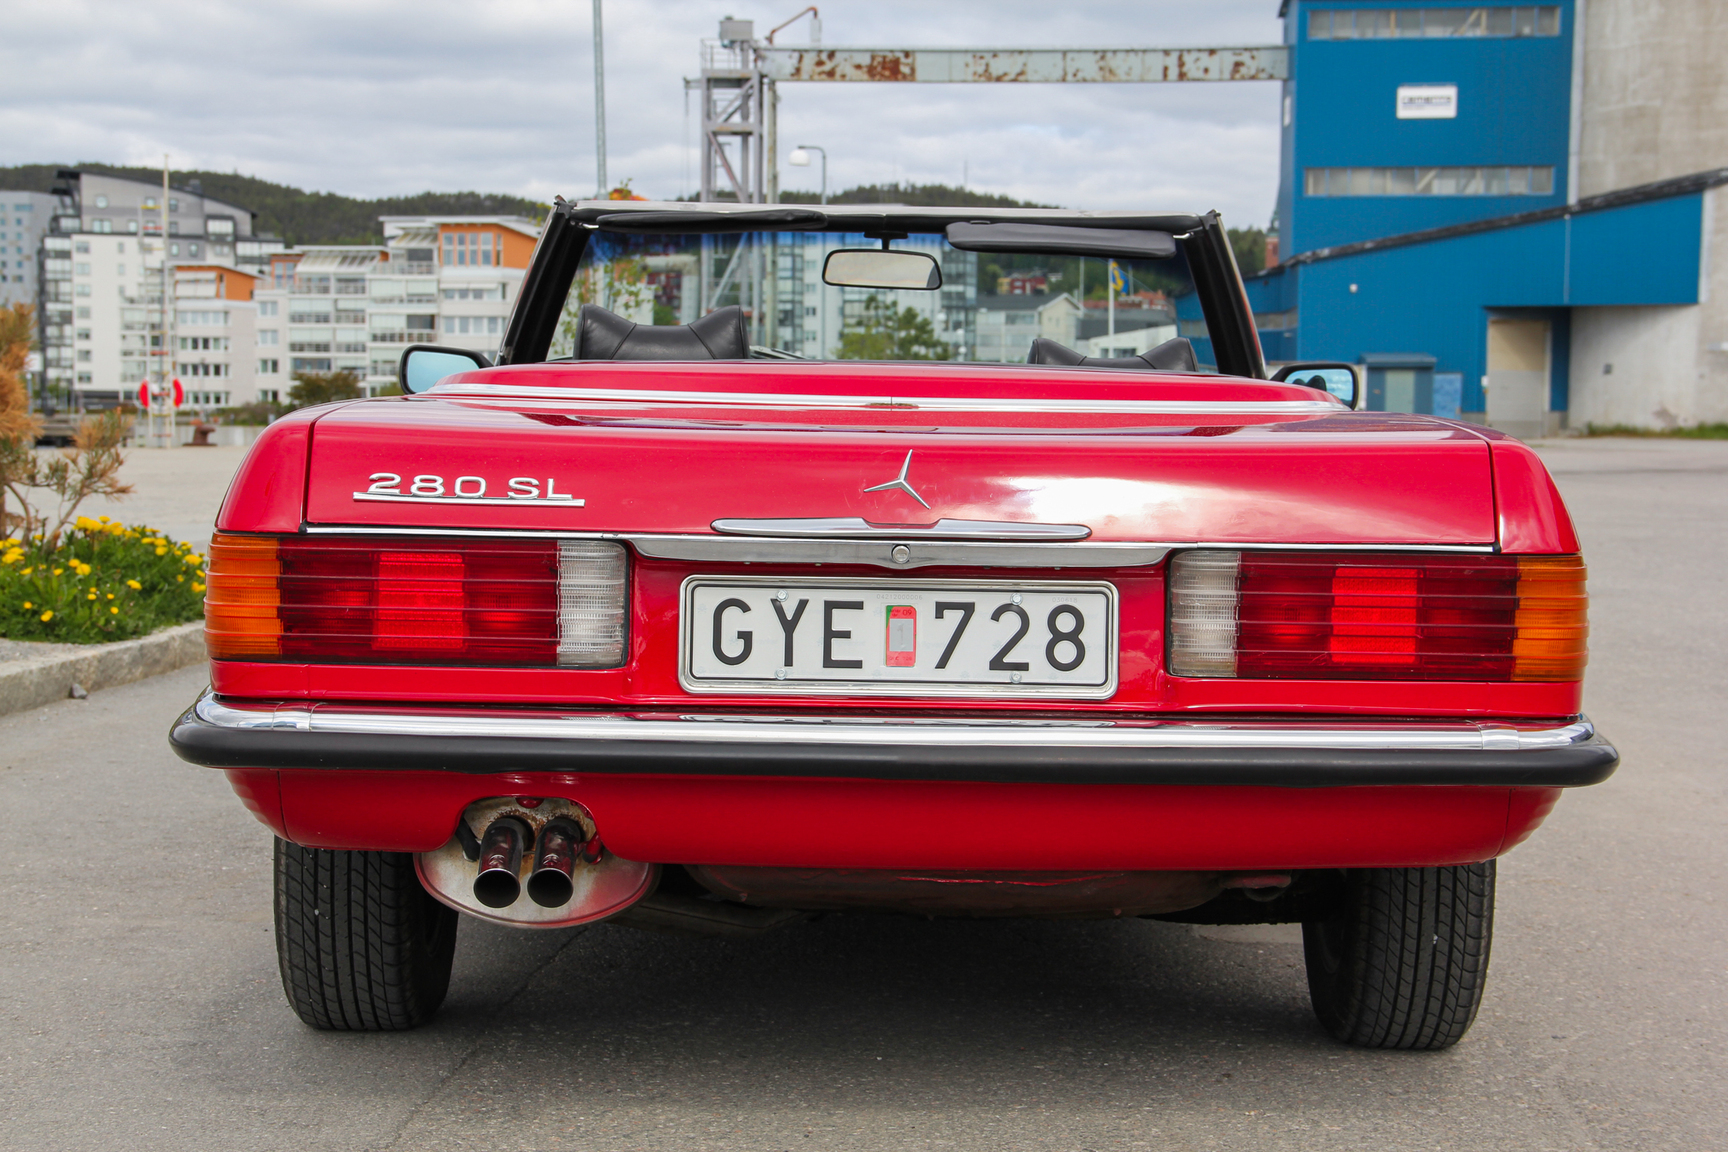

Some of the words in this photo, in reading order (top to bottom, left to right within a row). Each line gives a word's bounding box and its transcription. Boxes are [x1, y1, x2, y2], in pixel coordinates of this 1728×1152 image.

[367, 472, 487, 498] 280
[507, 477, 573, 500] SL
[712, 597, 864, 669] GYE
[934, 601, 1086, 672] 728
